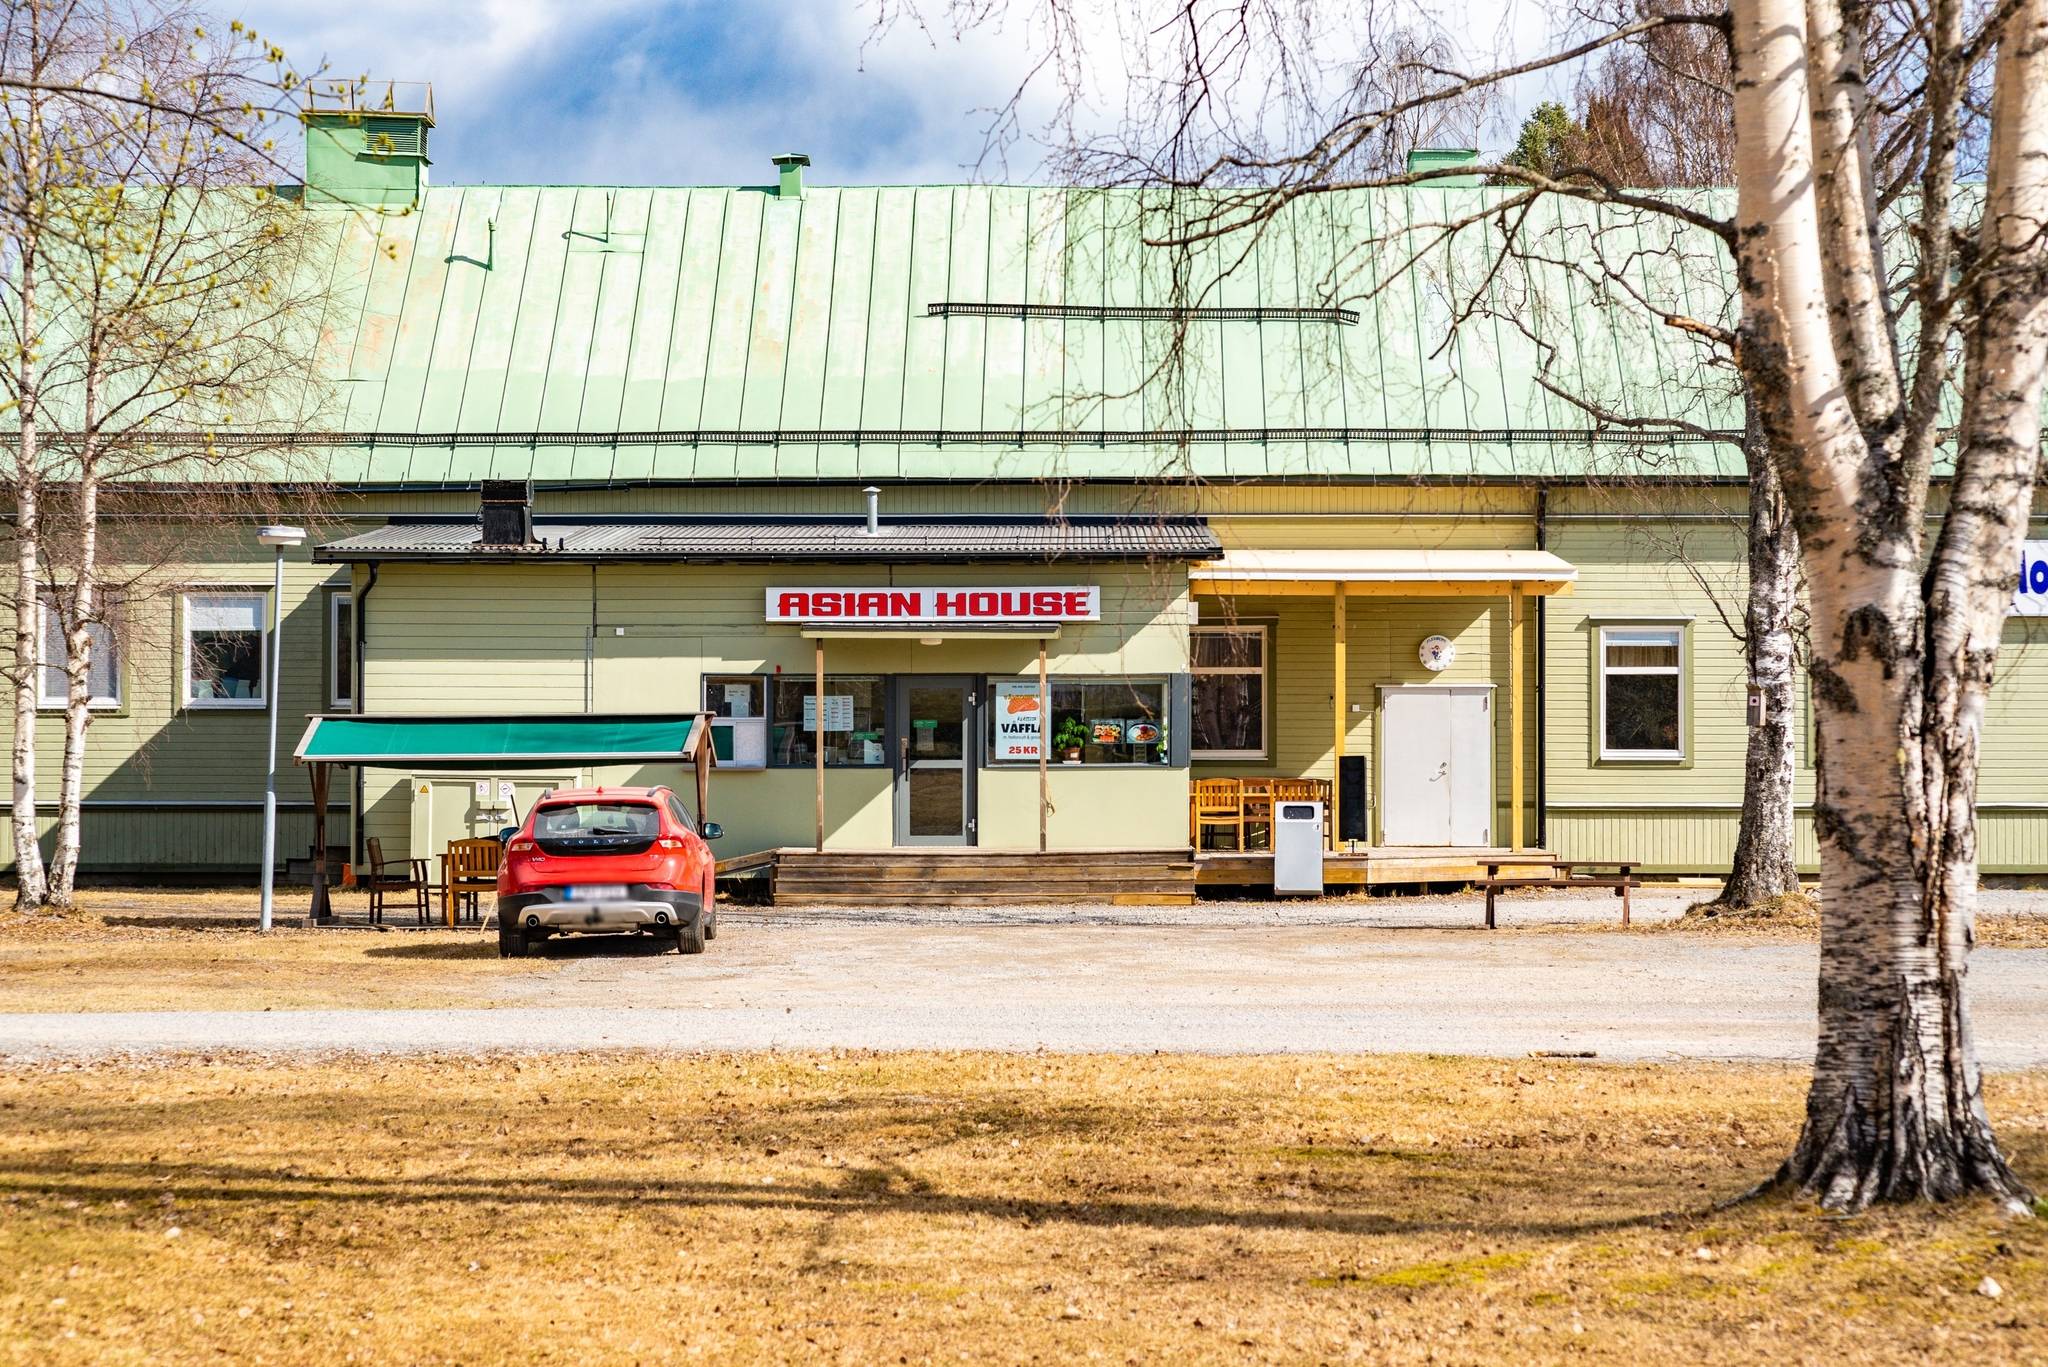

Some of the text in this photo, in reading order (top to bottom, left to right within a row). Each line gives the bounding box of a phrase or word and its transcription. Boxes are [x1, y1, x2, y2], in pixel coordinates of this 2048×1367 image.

[777, 592, 1091, 617] ASIAN HOUSE
[1009, 746, 1038, 754] 25 KR
